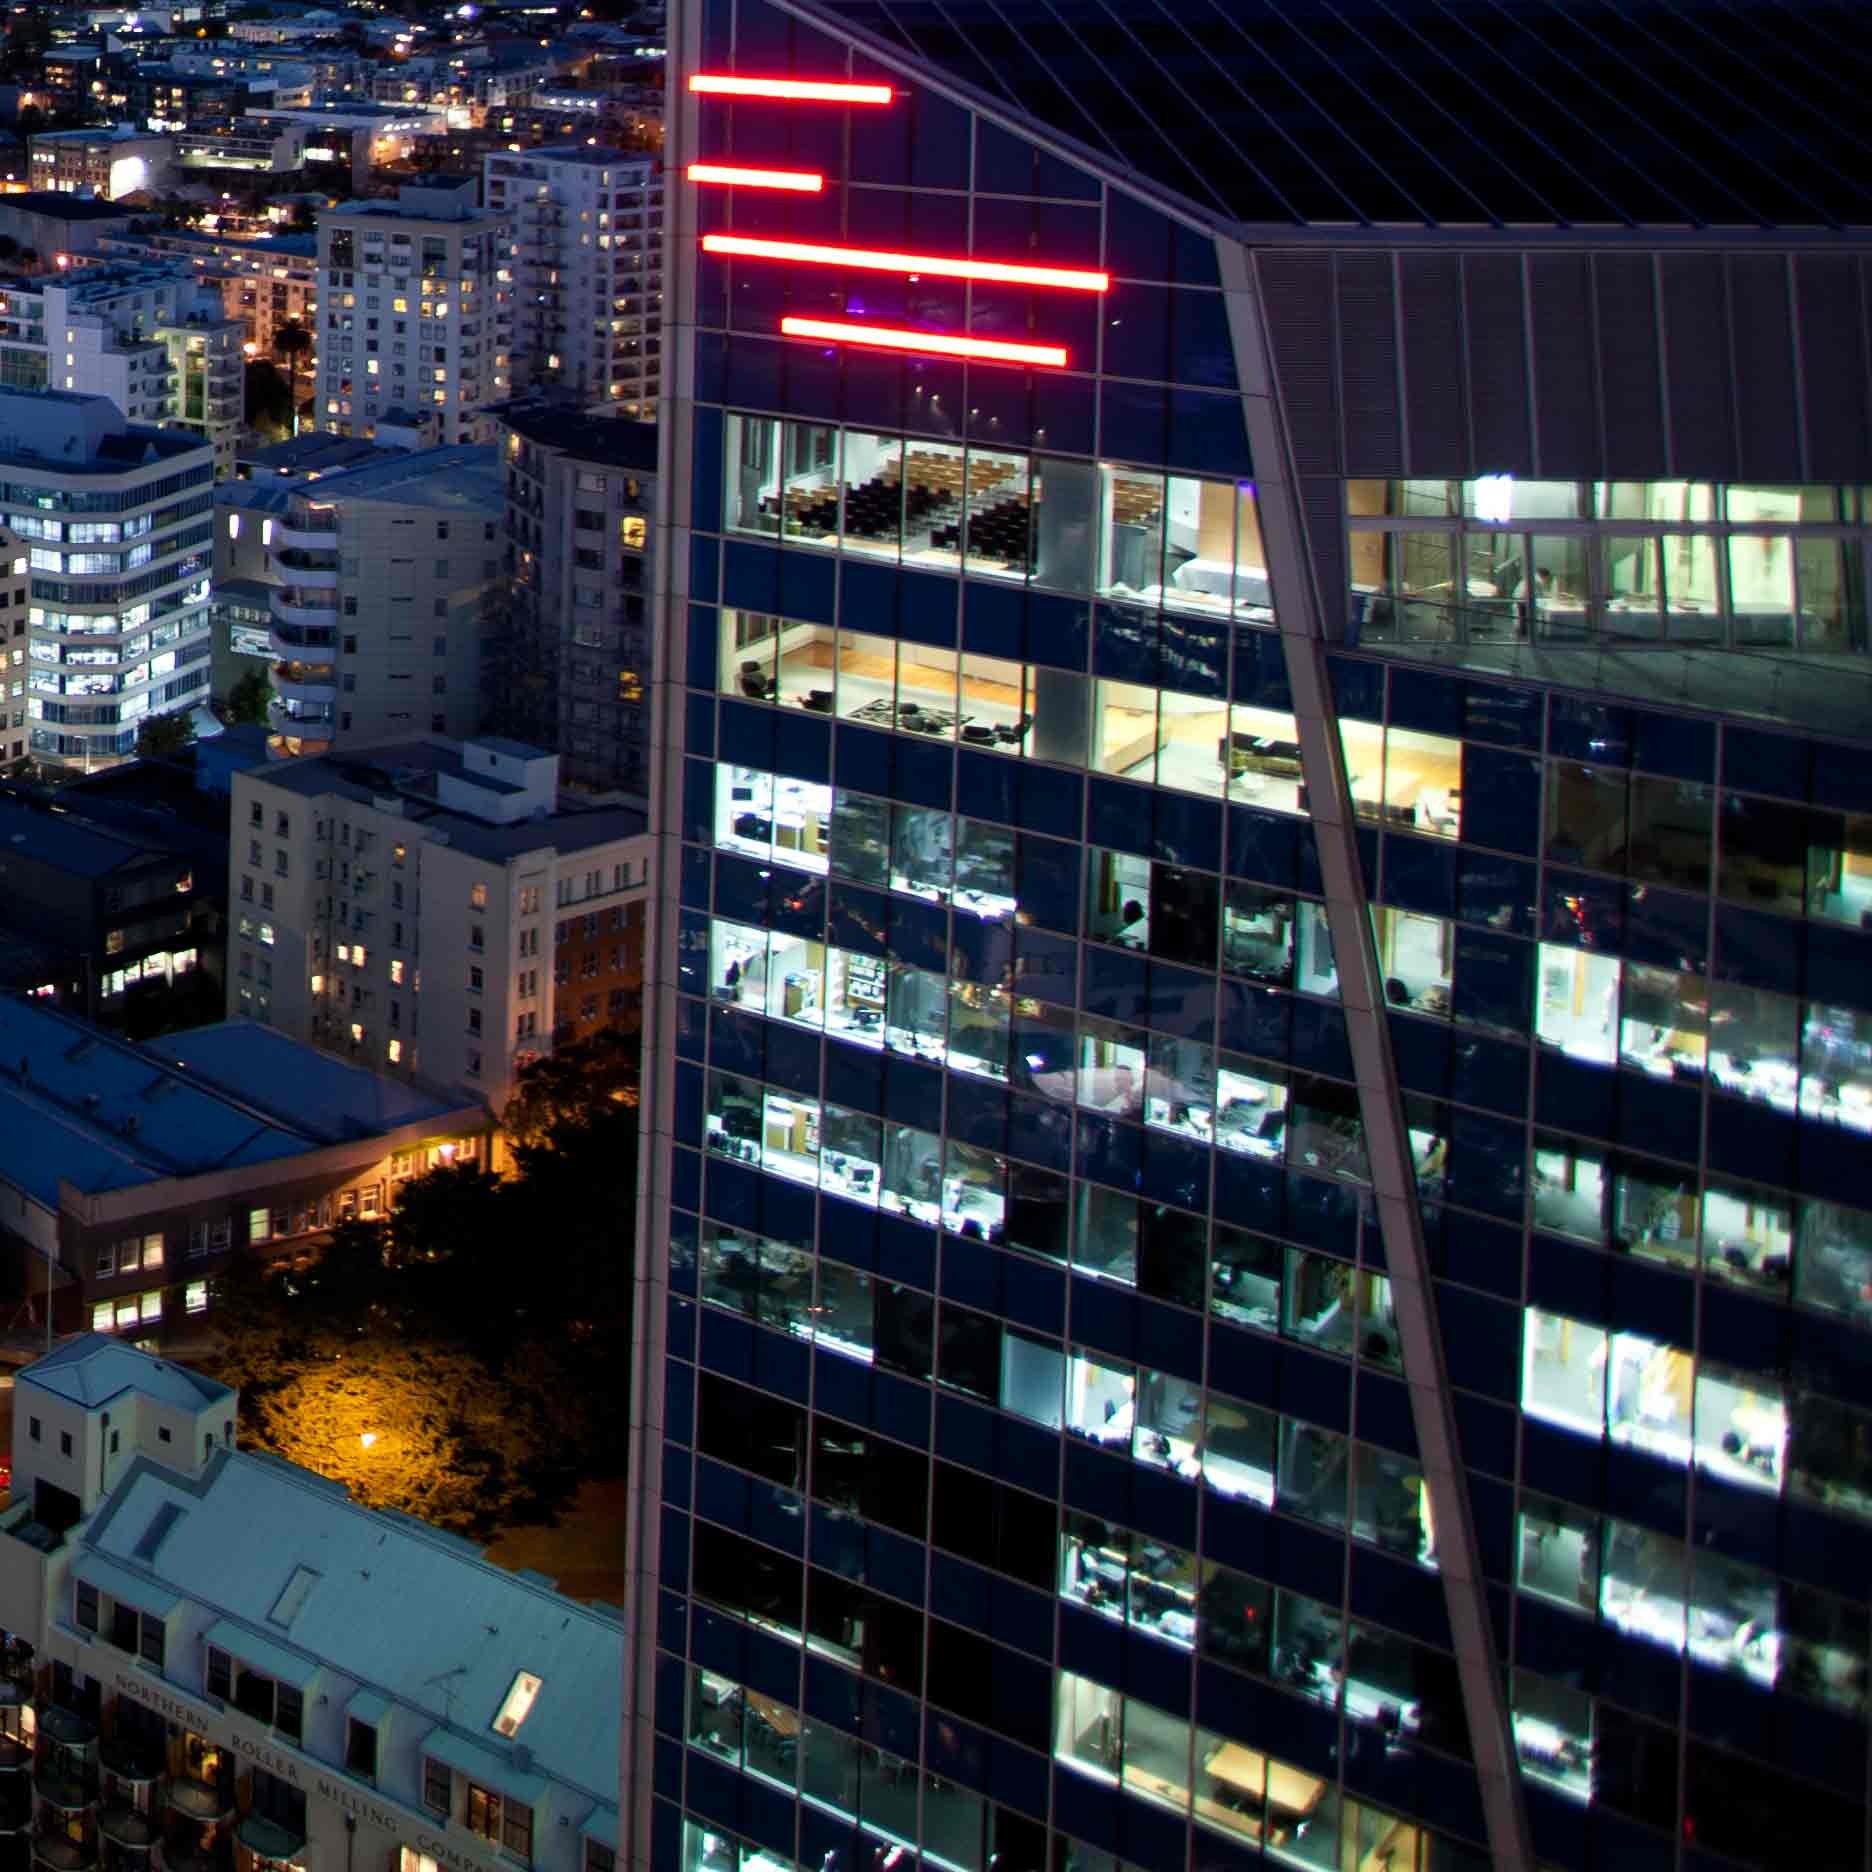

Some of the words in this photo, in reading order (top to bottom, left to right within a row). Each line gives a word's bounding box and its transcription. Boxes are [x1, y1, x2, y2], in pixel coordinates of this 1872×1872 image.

[113, 1673, 208, 1730] NORTHERN
[231, 1733, 297, 1780] ROLLER
[318, 1780, 398, 1832] MILLING
